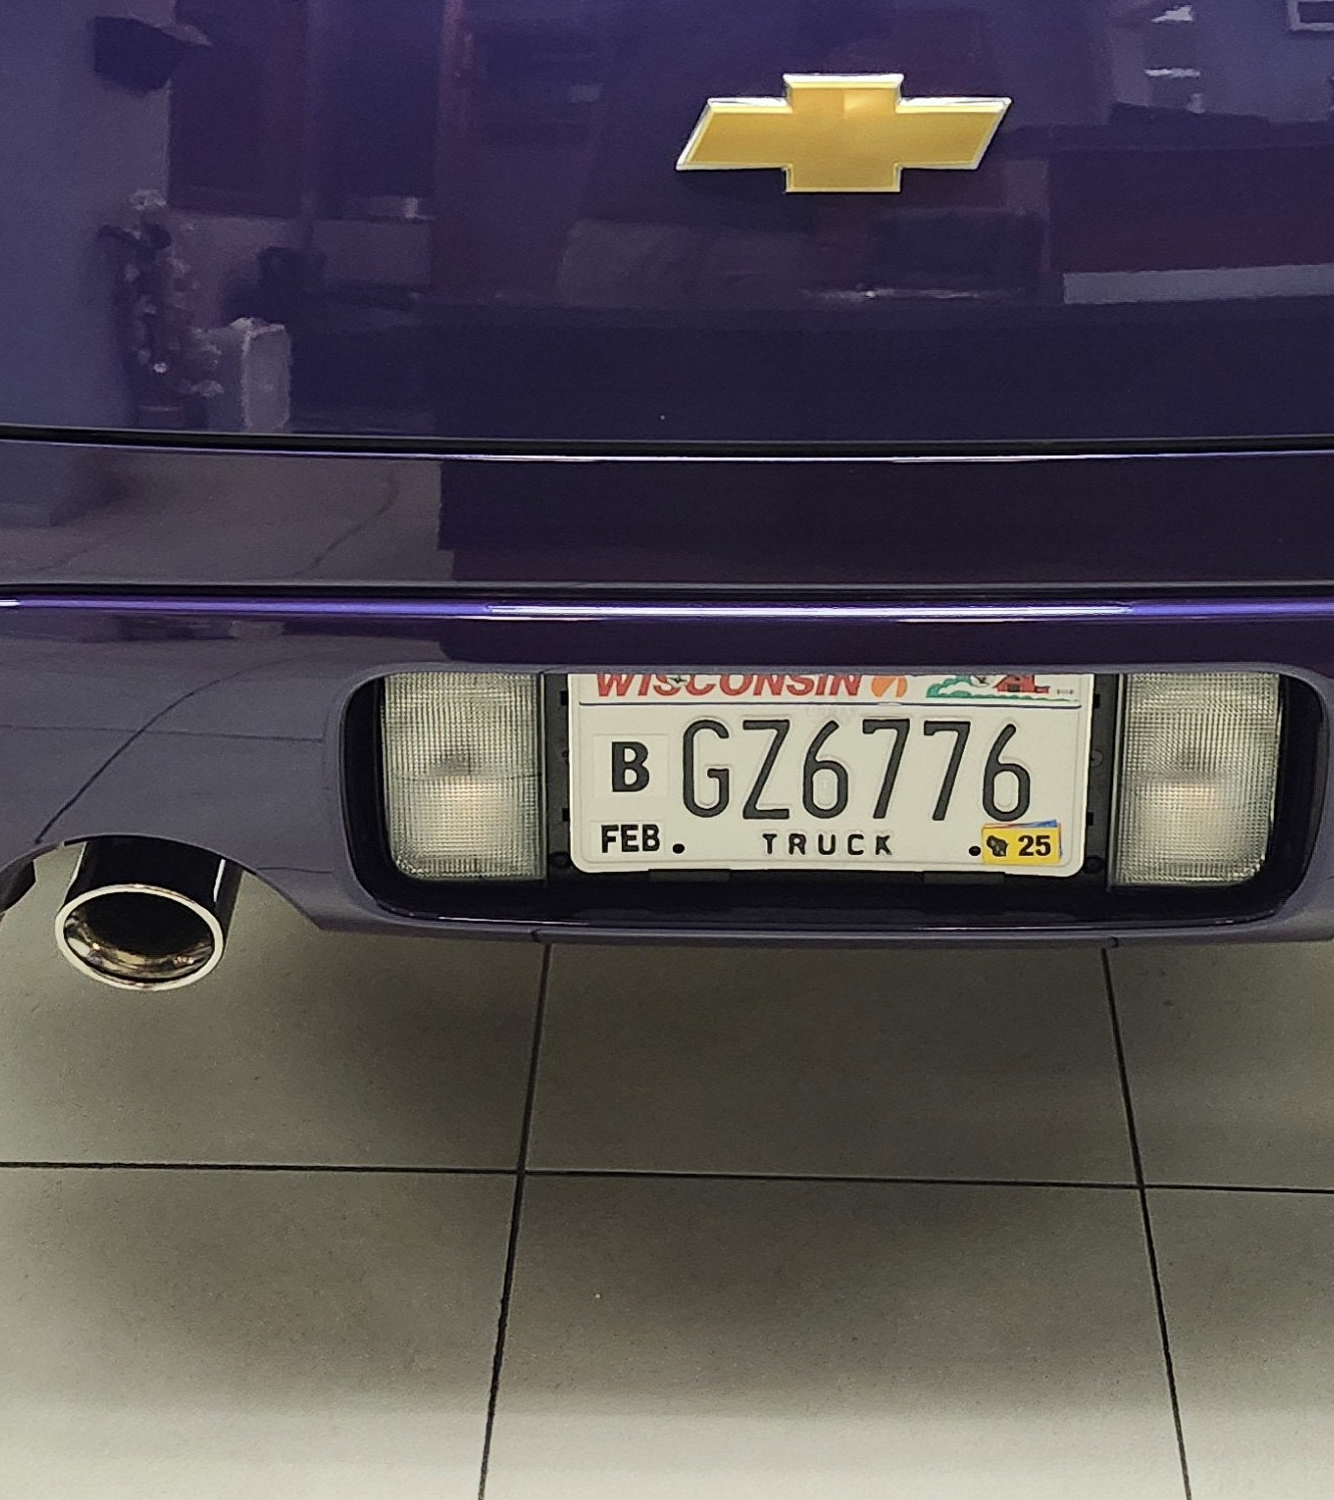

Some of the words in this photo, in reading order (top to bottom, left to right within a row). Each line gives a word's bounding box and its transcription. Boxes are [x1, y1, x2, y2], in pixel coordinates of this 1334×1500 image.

[596, 673, 862, 697] WISCONSIN
[610, 741, 651, 793] B
[681, 718, 1032, 822] GZ6776
[762, 832, 893, 857] TRUCK
[1018, 834, 1052, 857] 25
